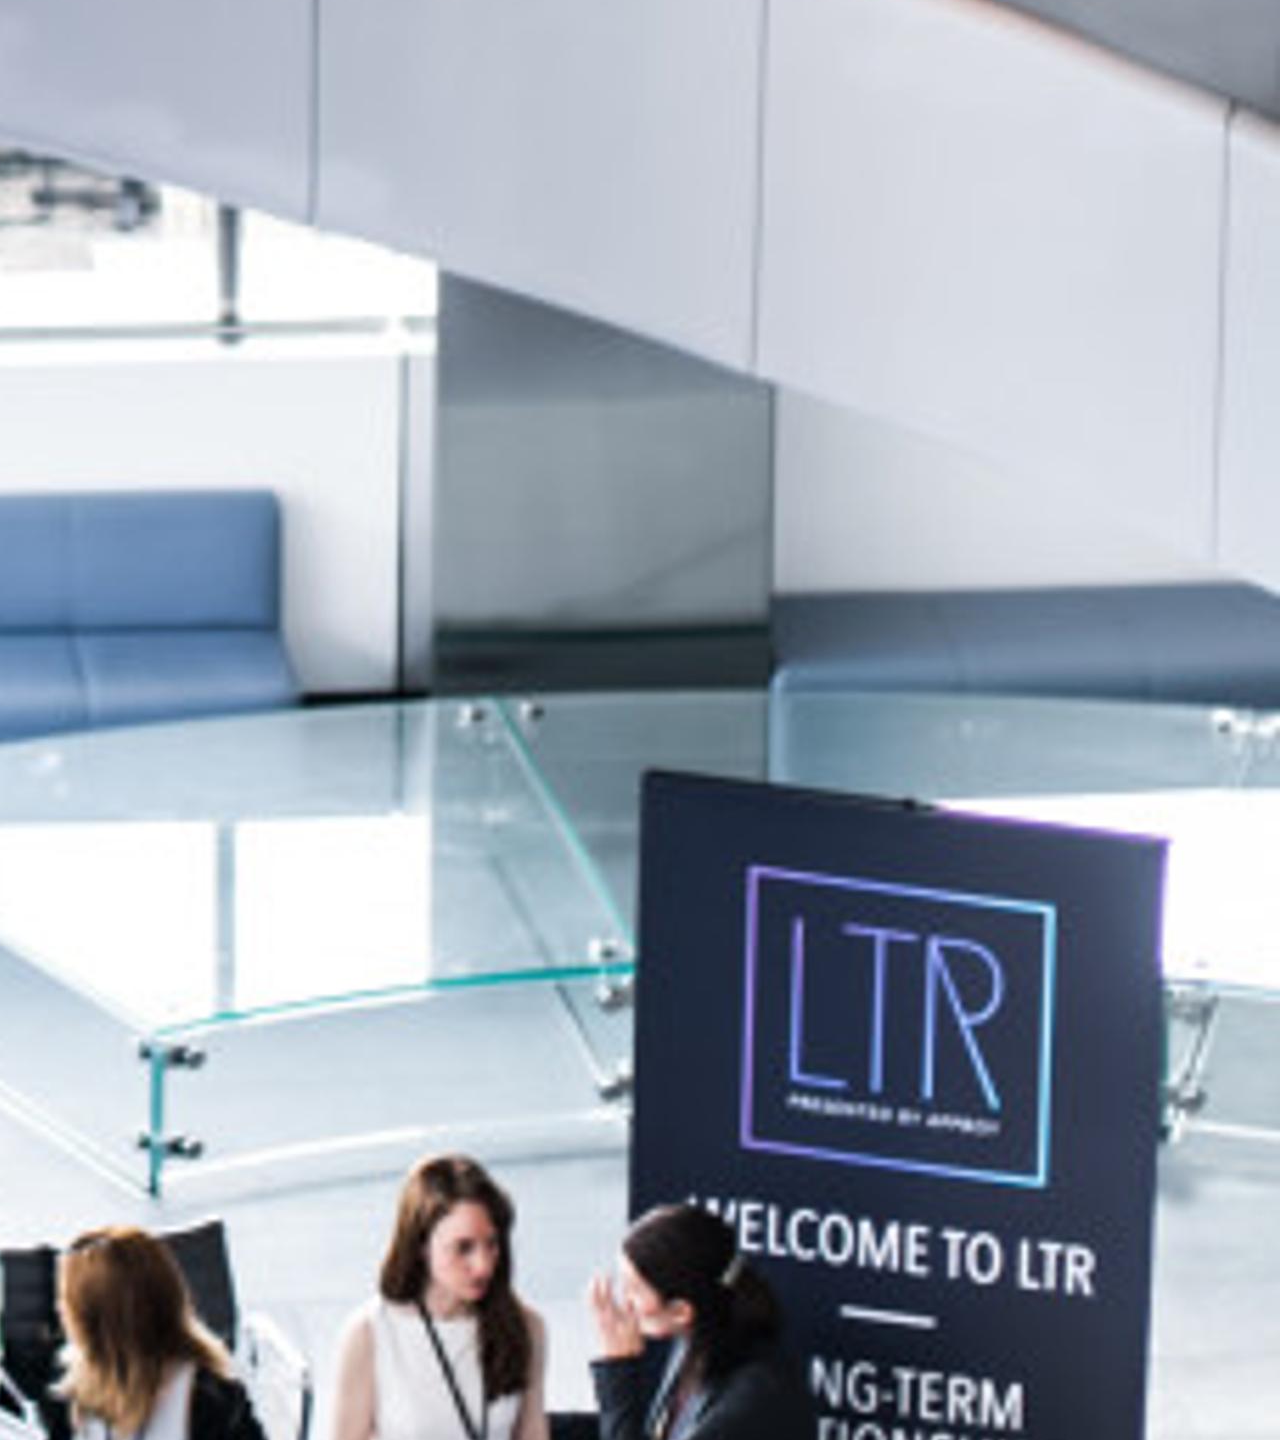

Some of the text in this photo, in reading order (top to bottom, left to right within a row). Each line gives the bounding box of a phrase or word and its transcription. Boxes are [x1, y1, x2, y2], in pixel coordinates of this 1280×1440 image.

[788, 914, 1006, 1112] LTR
[786, 1092, 893, 1122] PRESENTED
[897, 1108, 922, 1127] BY
[687, 1194, 1097, 1299] ELCOME TO LTR
[810, 1356, 1024, 1432] NG-TERM
